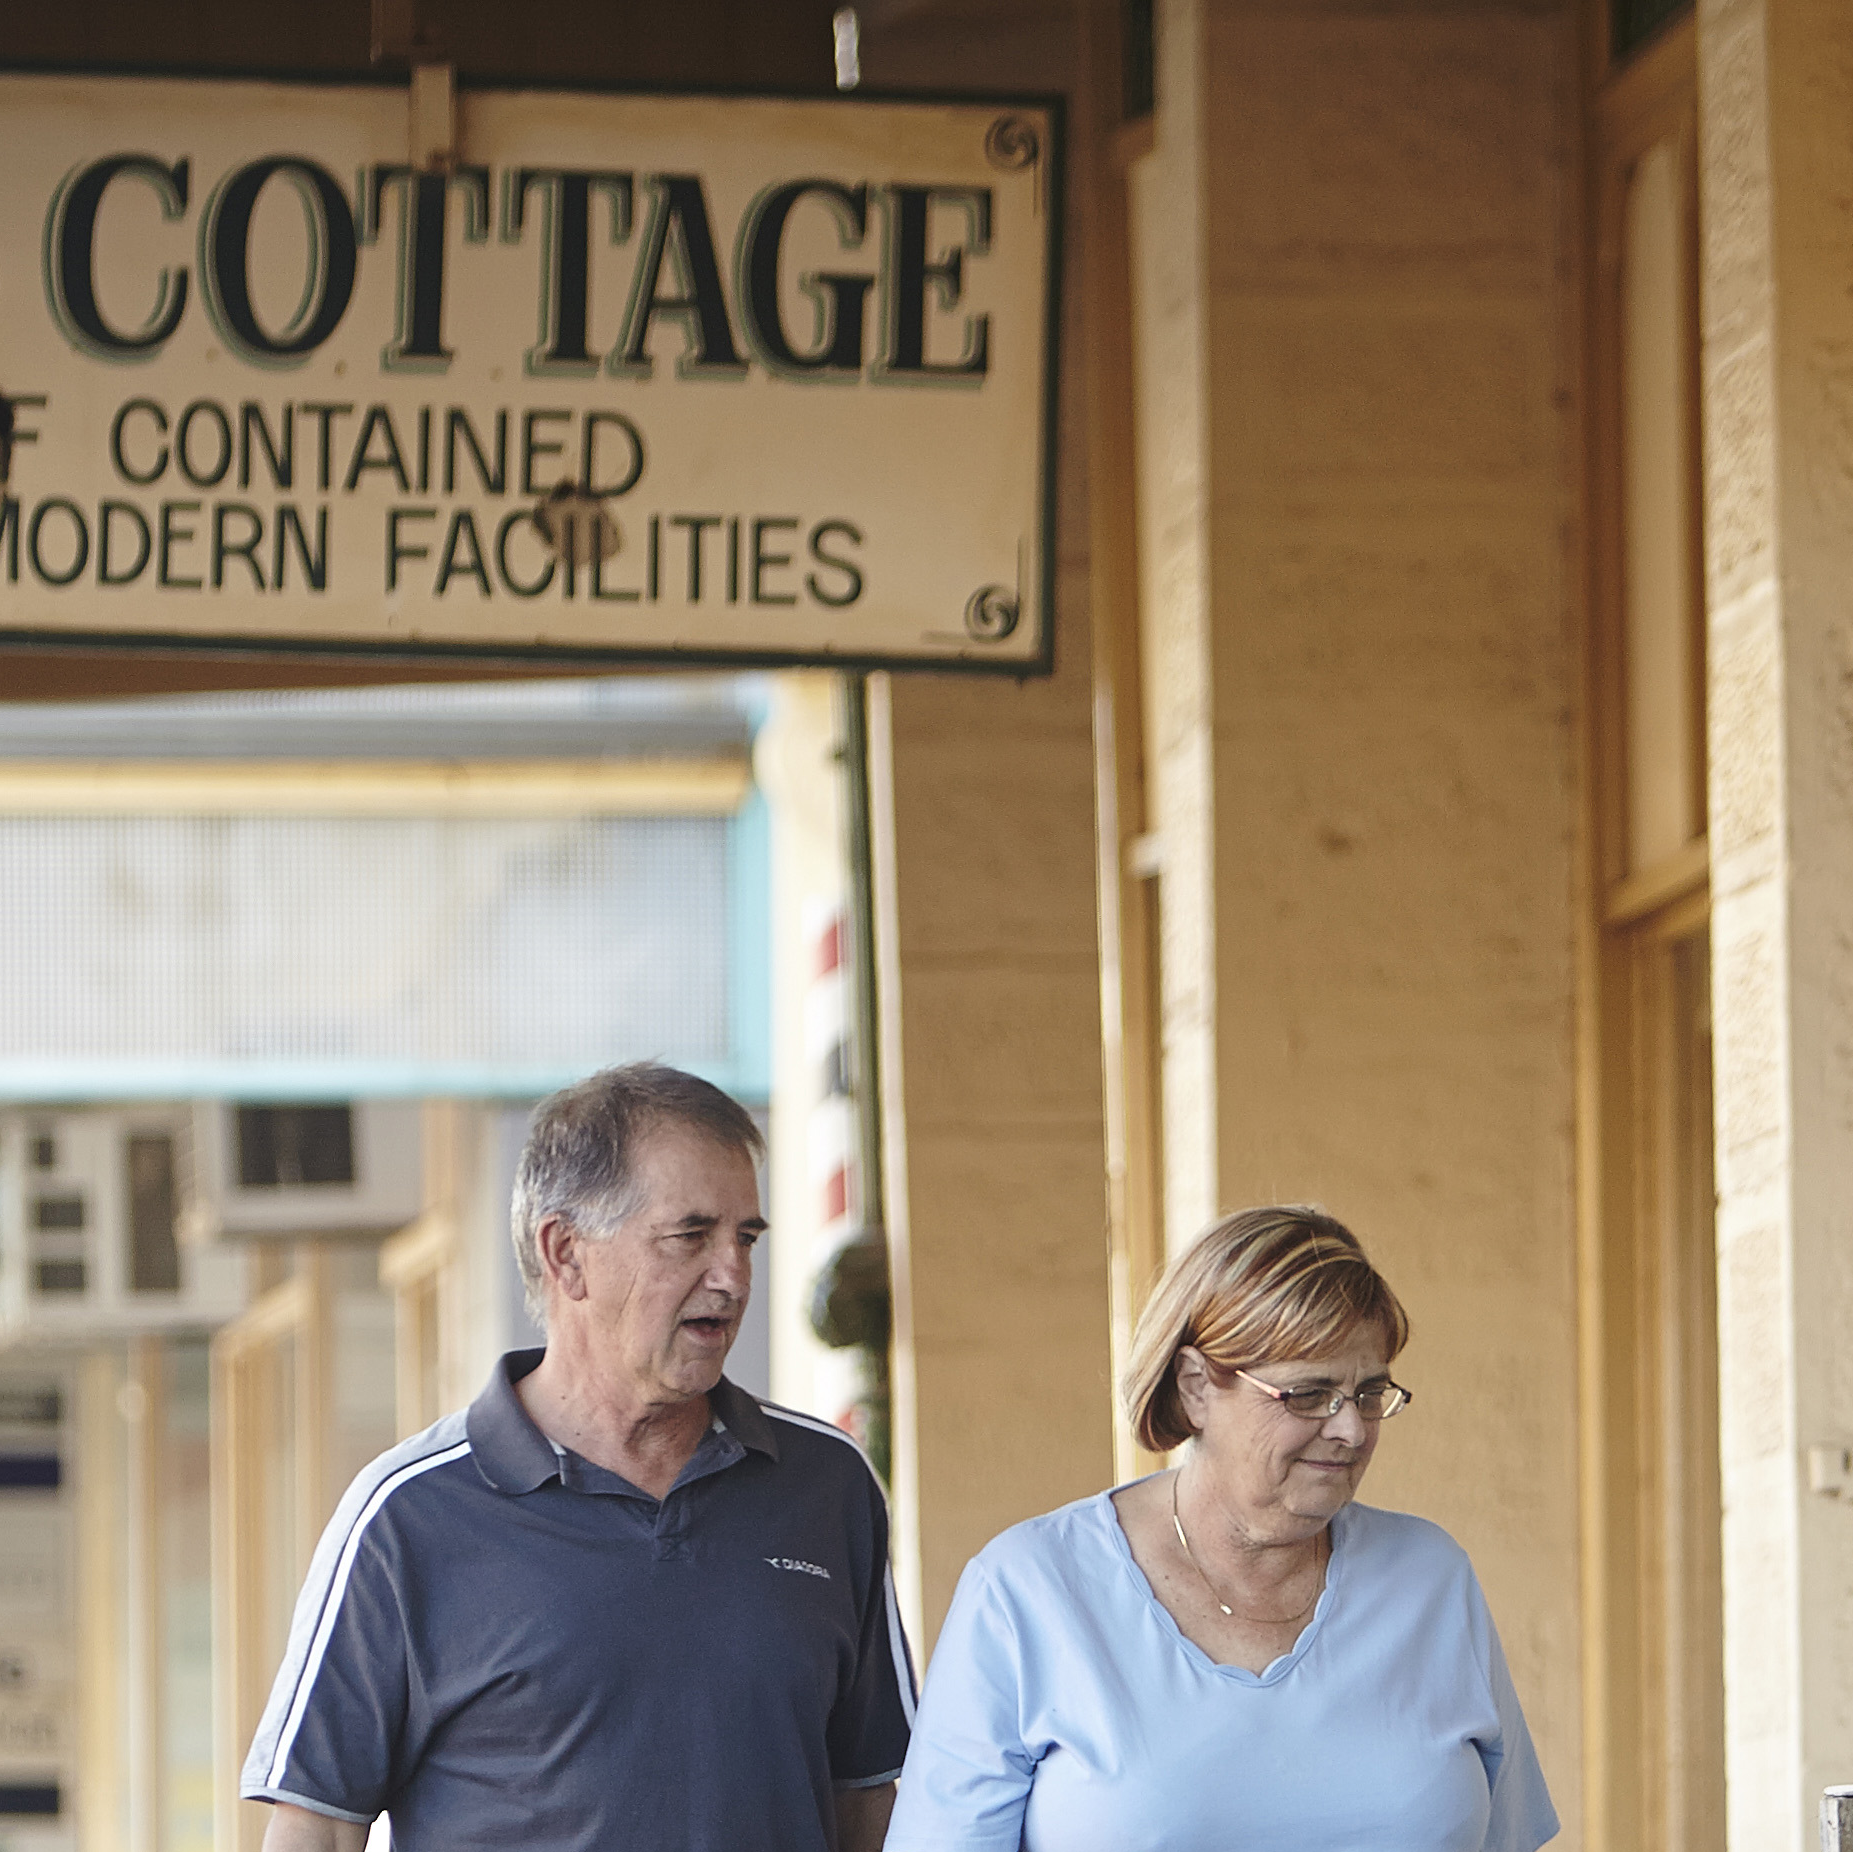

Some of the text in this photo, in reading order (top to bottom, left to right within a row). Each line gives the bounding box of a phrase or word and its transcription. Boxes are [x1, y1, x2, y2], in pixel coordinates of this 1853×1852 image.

[42, 152, 995, 386] COTTAGE
[108, 398, 646, 499] CONTAINED
[384, 508, 865, 607] FACILITIES
